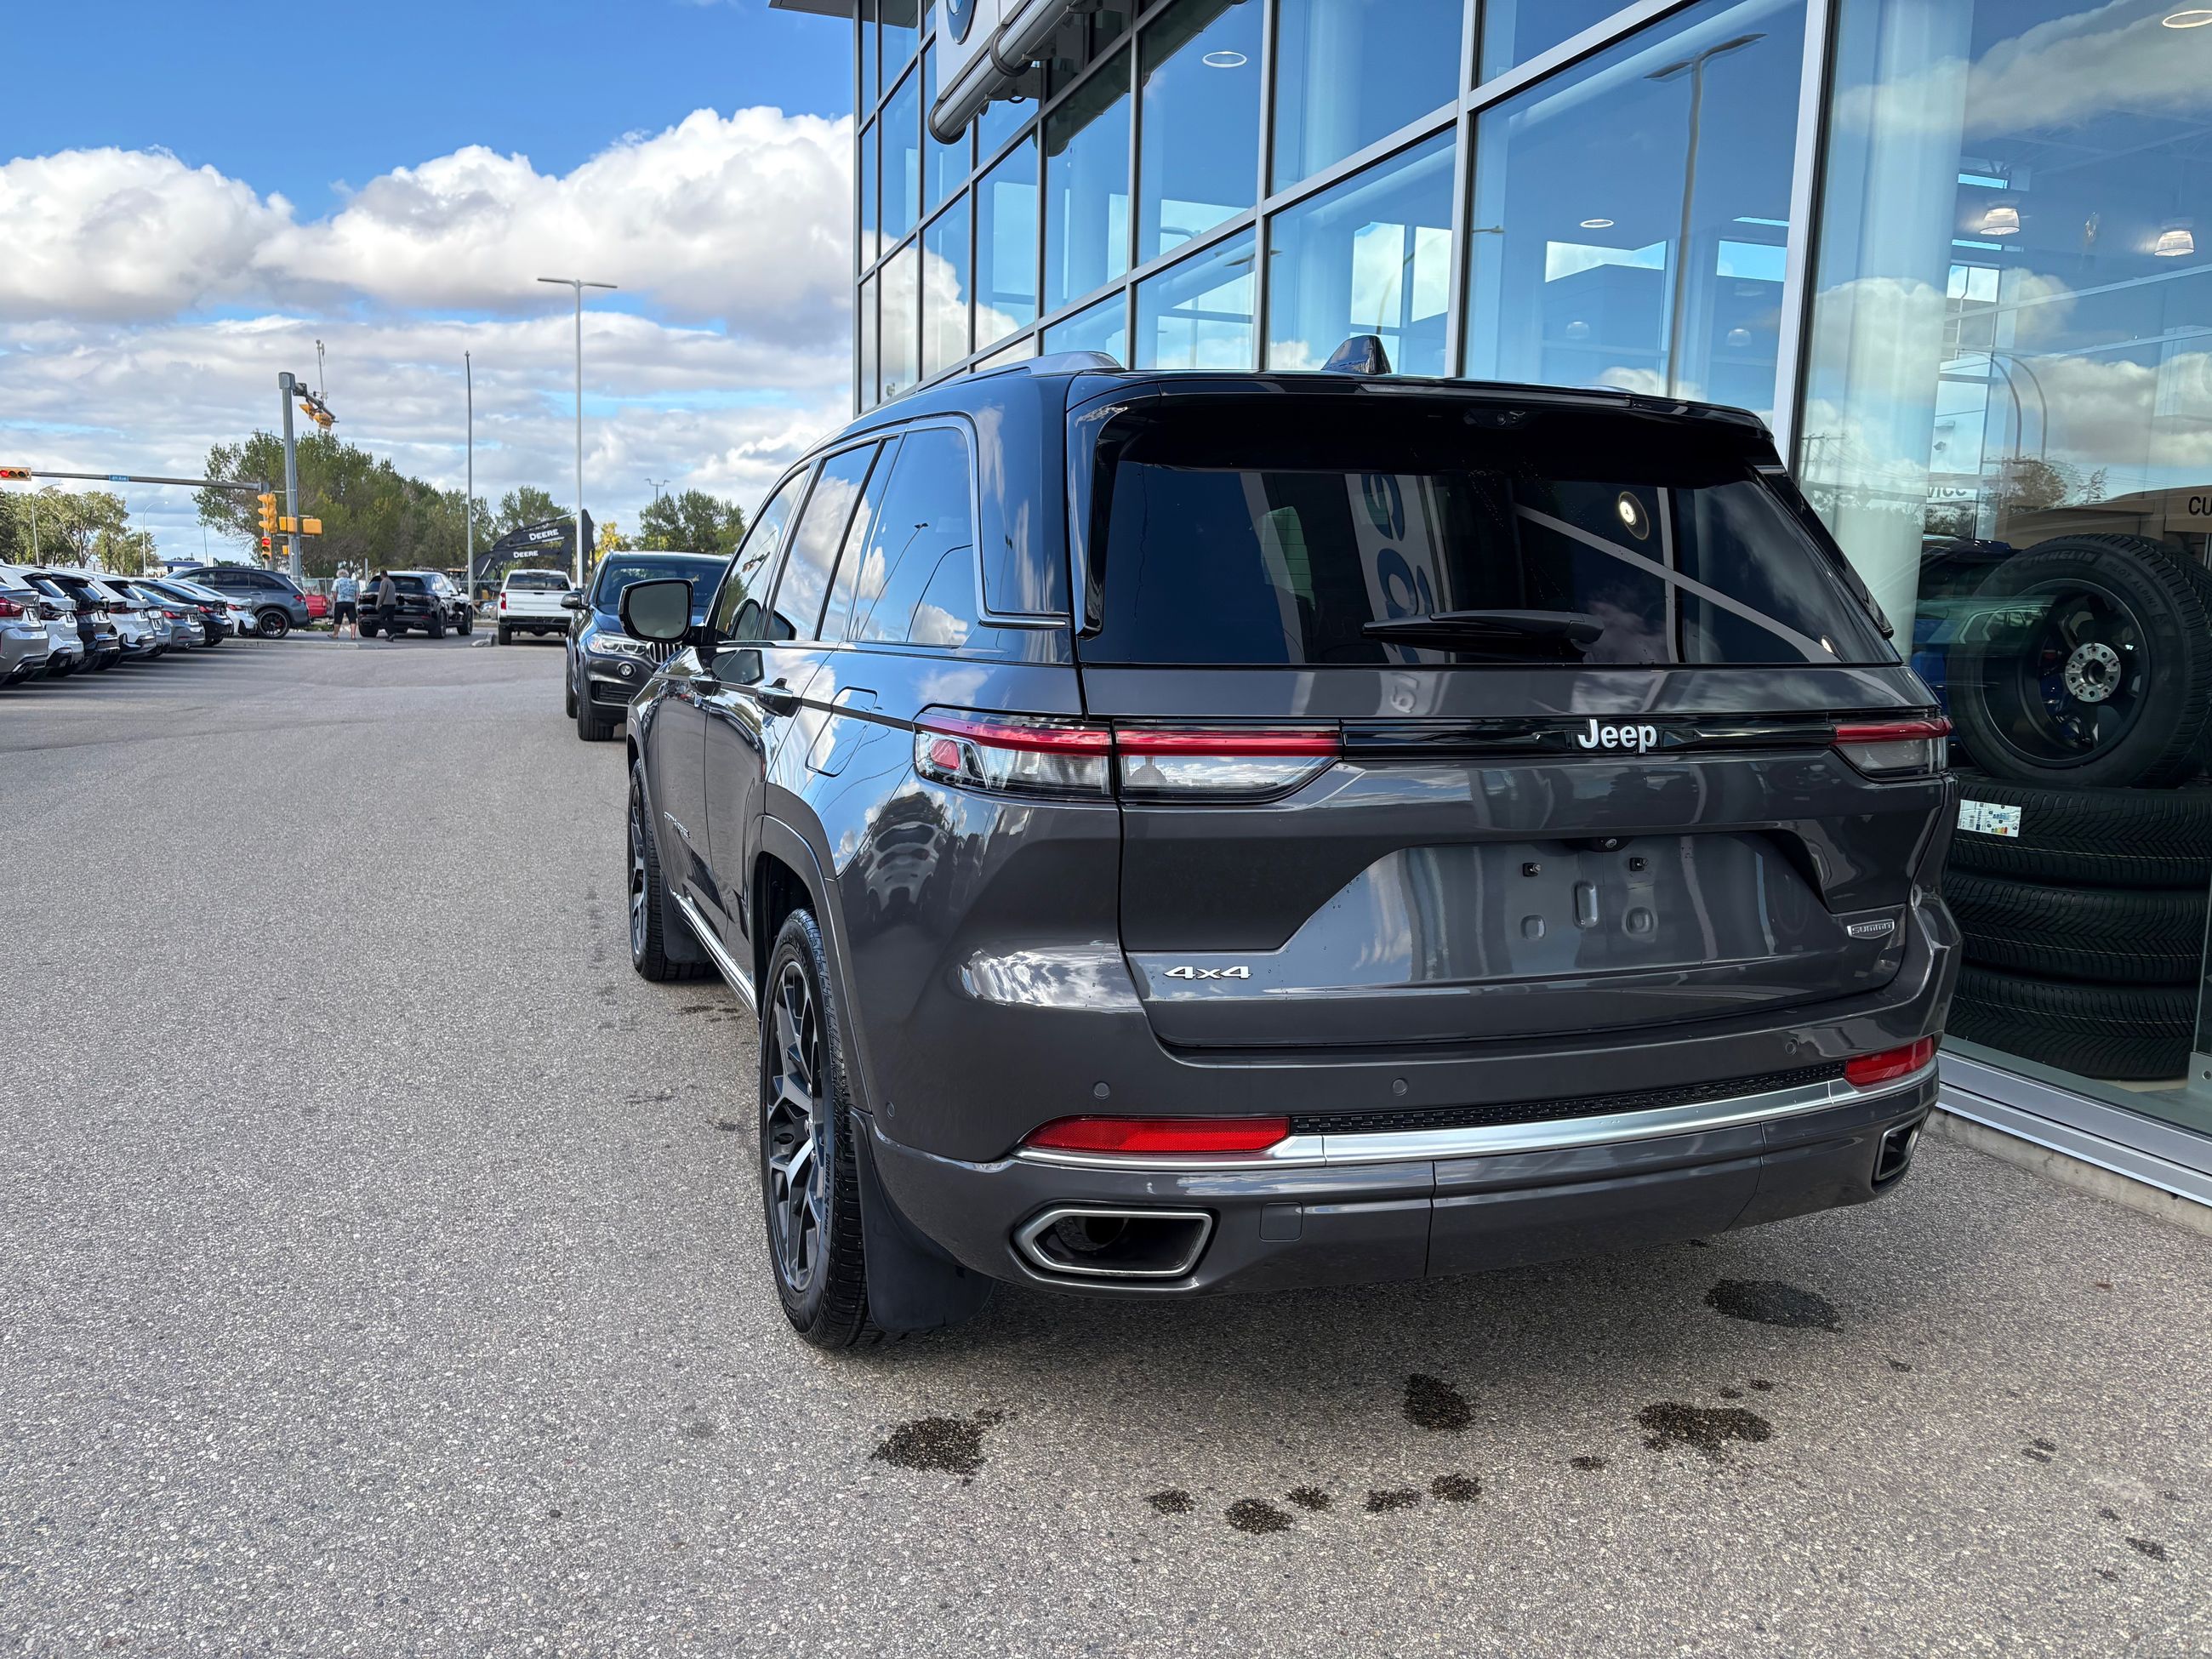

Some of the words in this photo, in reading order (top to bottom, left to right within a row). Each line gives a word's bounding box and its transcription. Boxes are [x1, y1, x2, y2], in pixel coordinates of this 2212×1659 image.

[528, 528, 559, 541] DEERE
[513, 550, 539, 558] DEERE
[1578, 718, 1657, 754] Jeep
[1164, 966, 1251, 979] 4x4
